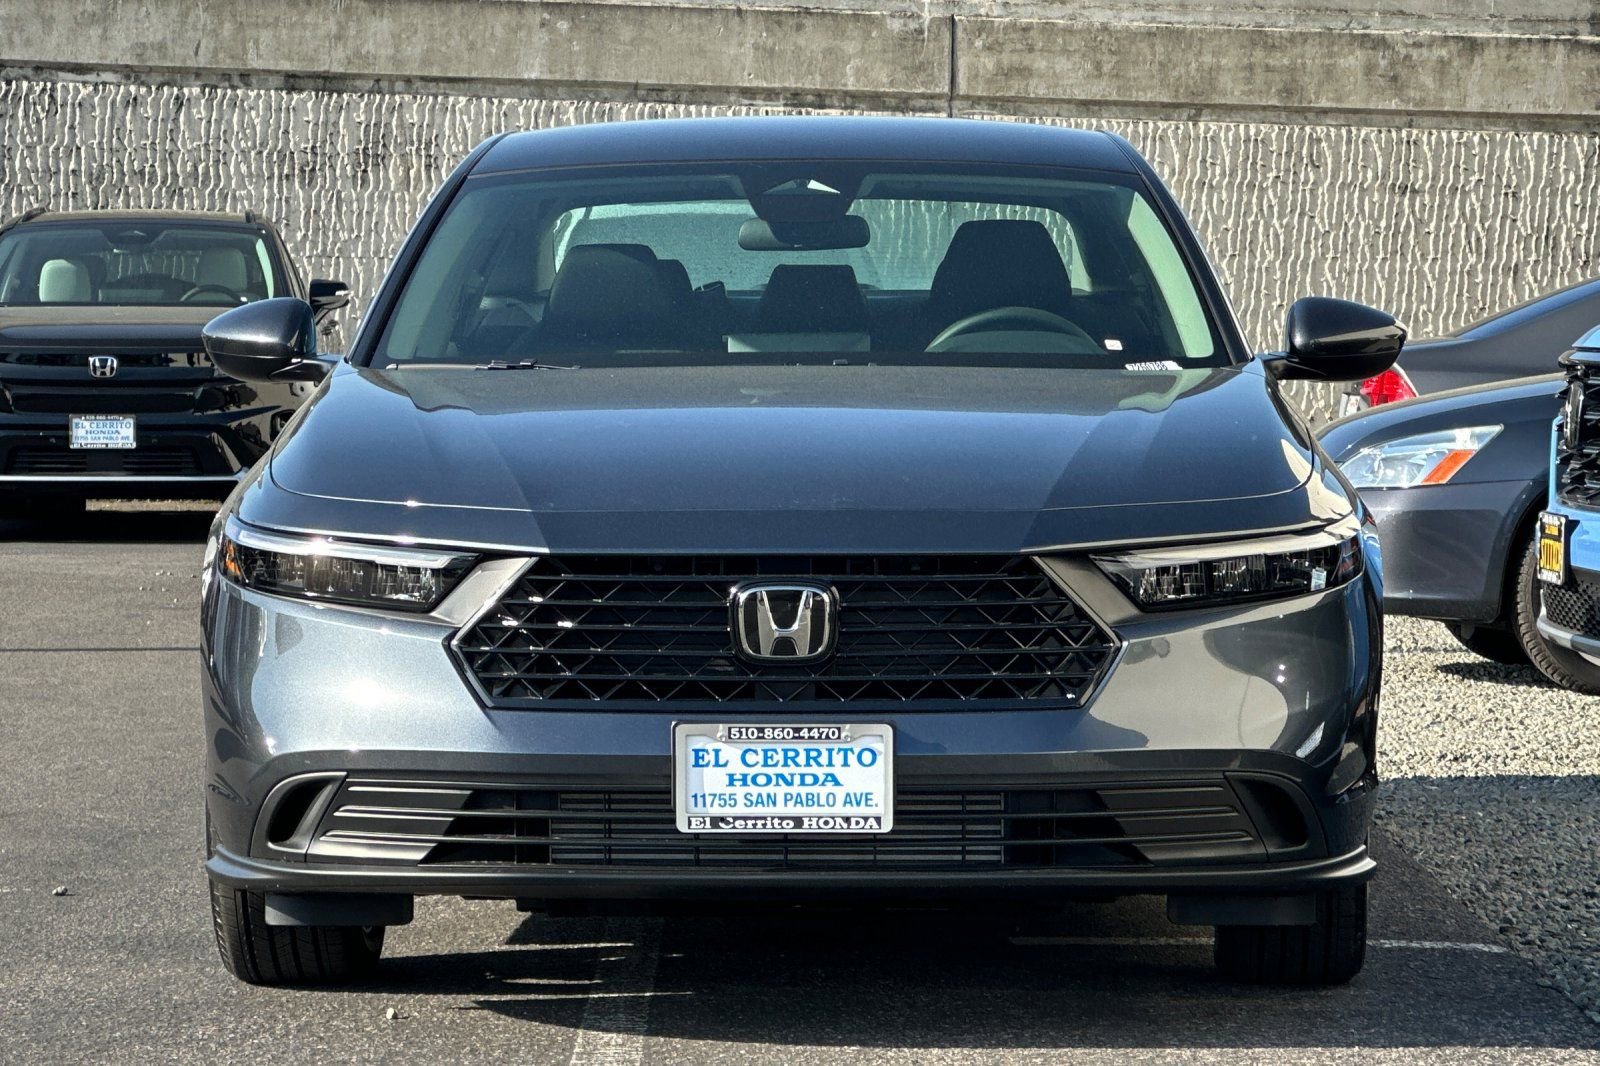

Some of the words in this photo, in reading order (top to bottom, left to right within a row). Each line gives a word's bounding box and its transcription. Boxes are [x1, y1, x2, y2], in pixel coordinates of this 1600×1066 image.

[74, 421, 86, 429] EL
[89, 421, 132, 429] CERRITO
[730, 727, 839, 740] 510-860-4470
[691, 748, 729, 768] EL
[740, 747, 878, 768] CERRITO
[725, 773, 844, 787] HONDA
[691, 792, 737, 808] 11755
[743, 792, 777, 807] SAN
[783, 792, 837, 807] PABLO
[842, 792, 879, 807] AVE.
[689, 817, 711, 829] El
[719, 816, 795, 829] Cerrito
[802, 817, 880, 829] HONDA
